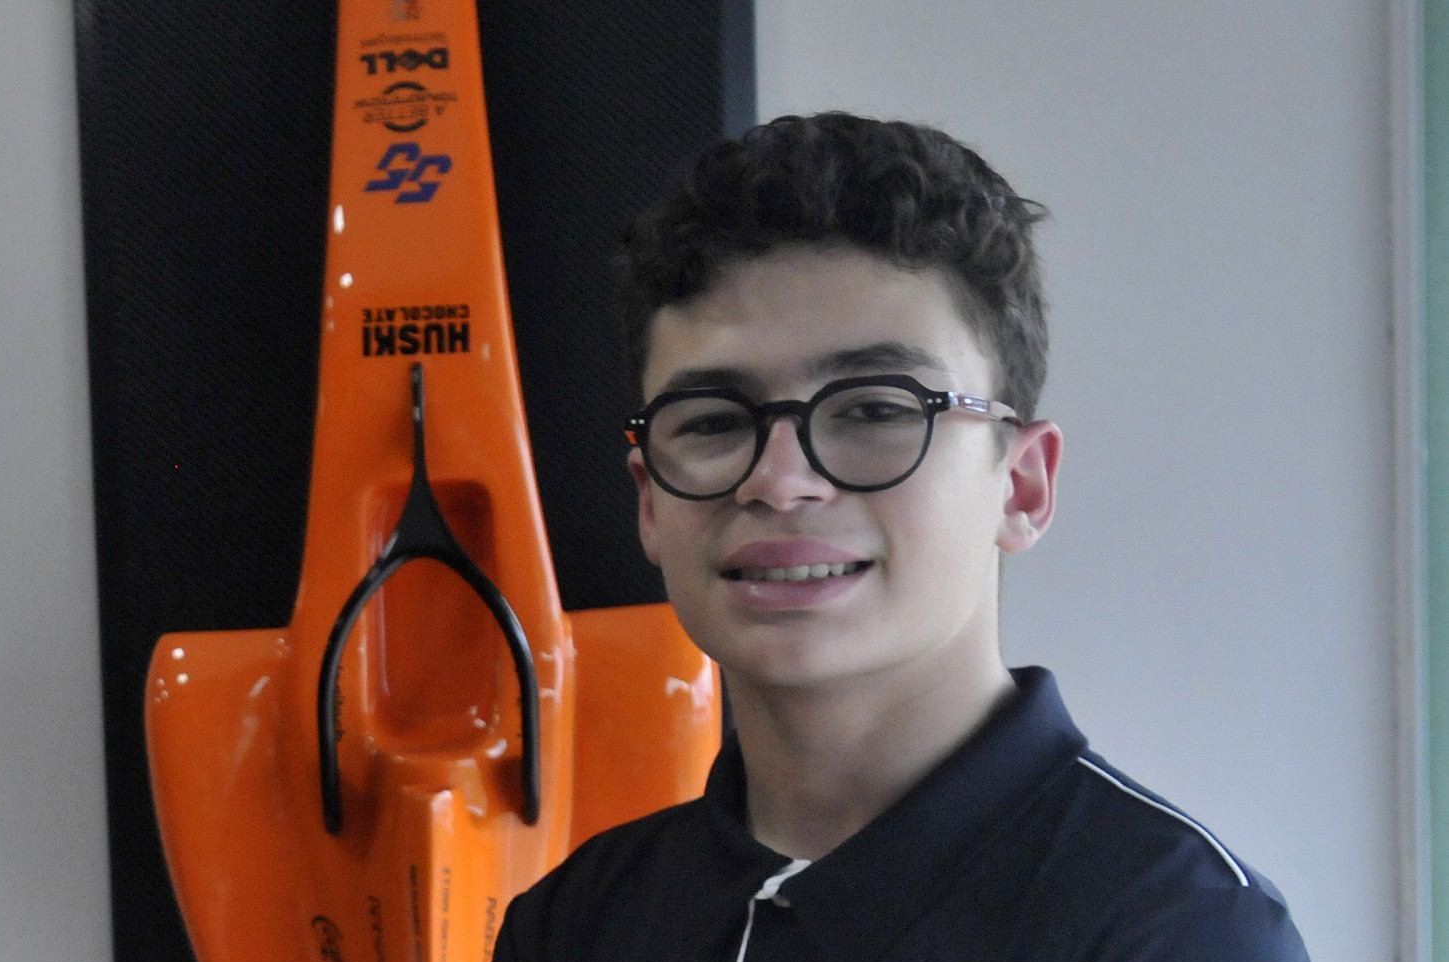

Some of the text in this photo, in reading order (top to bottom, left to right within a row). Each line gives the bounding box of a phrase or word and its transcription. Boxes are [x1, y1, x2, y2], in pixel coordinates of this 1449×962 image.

[364, 142, 452, 204] 55
[362, 303, 470, 323] CHOCOLATE
[361, 321, 471, 358] HUSKI
